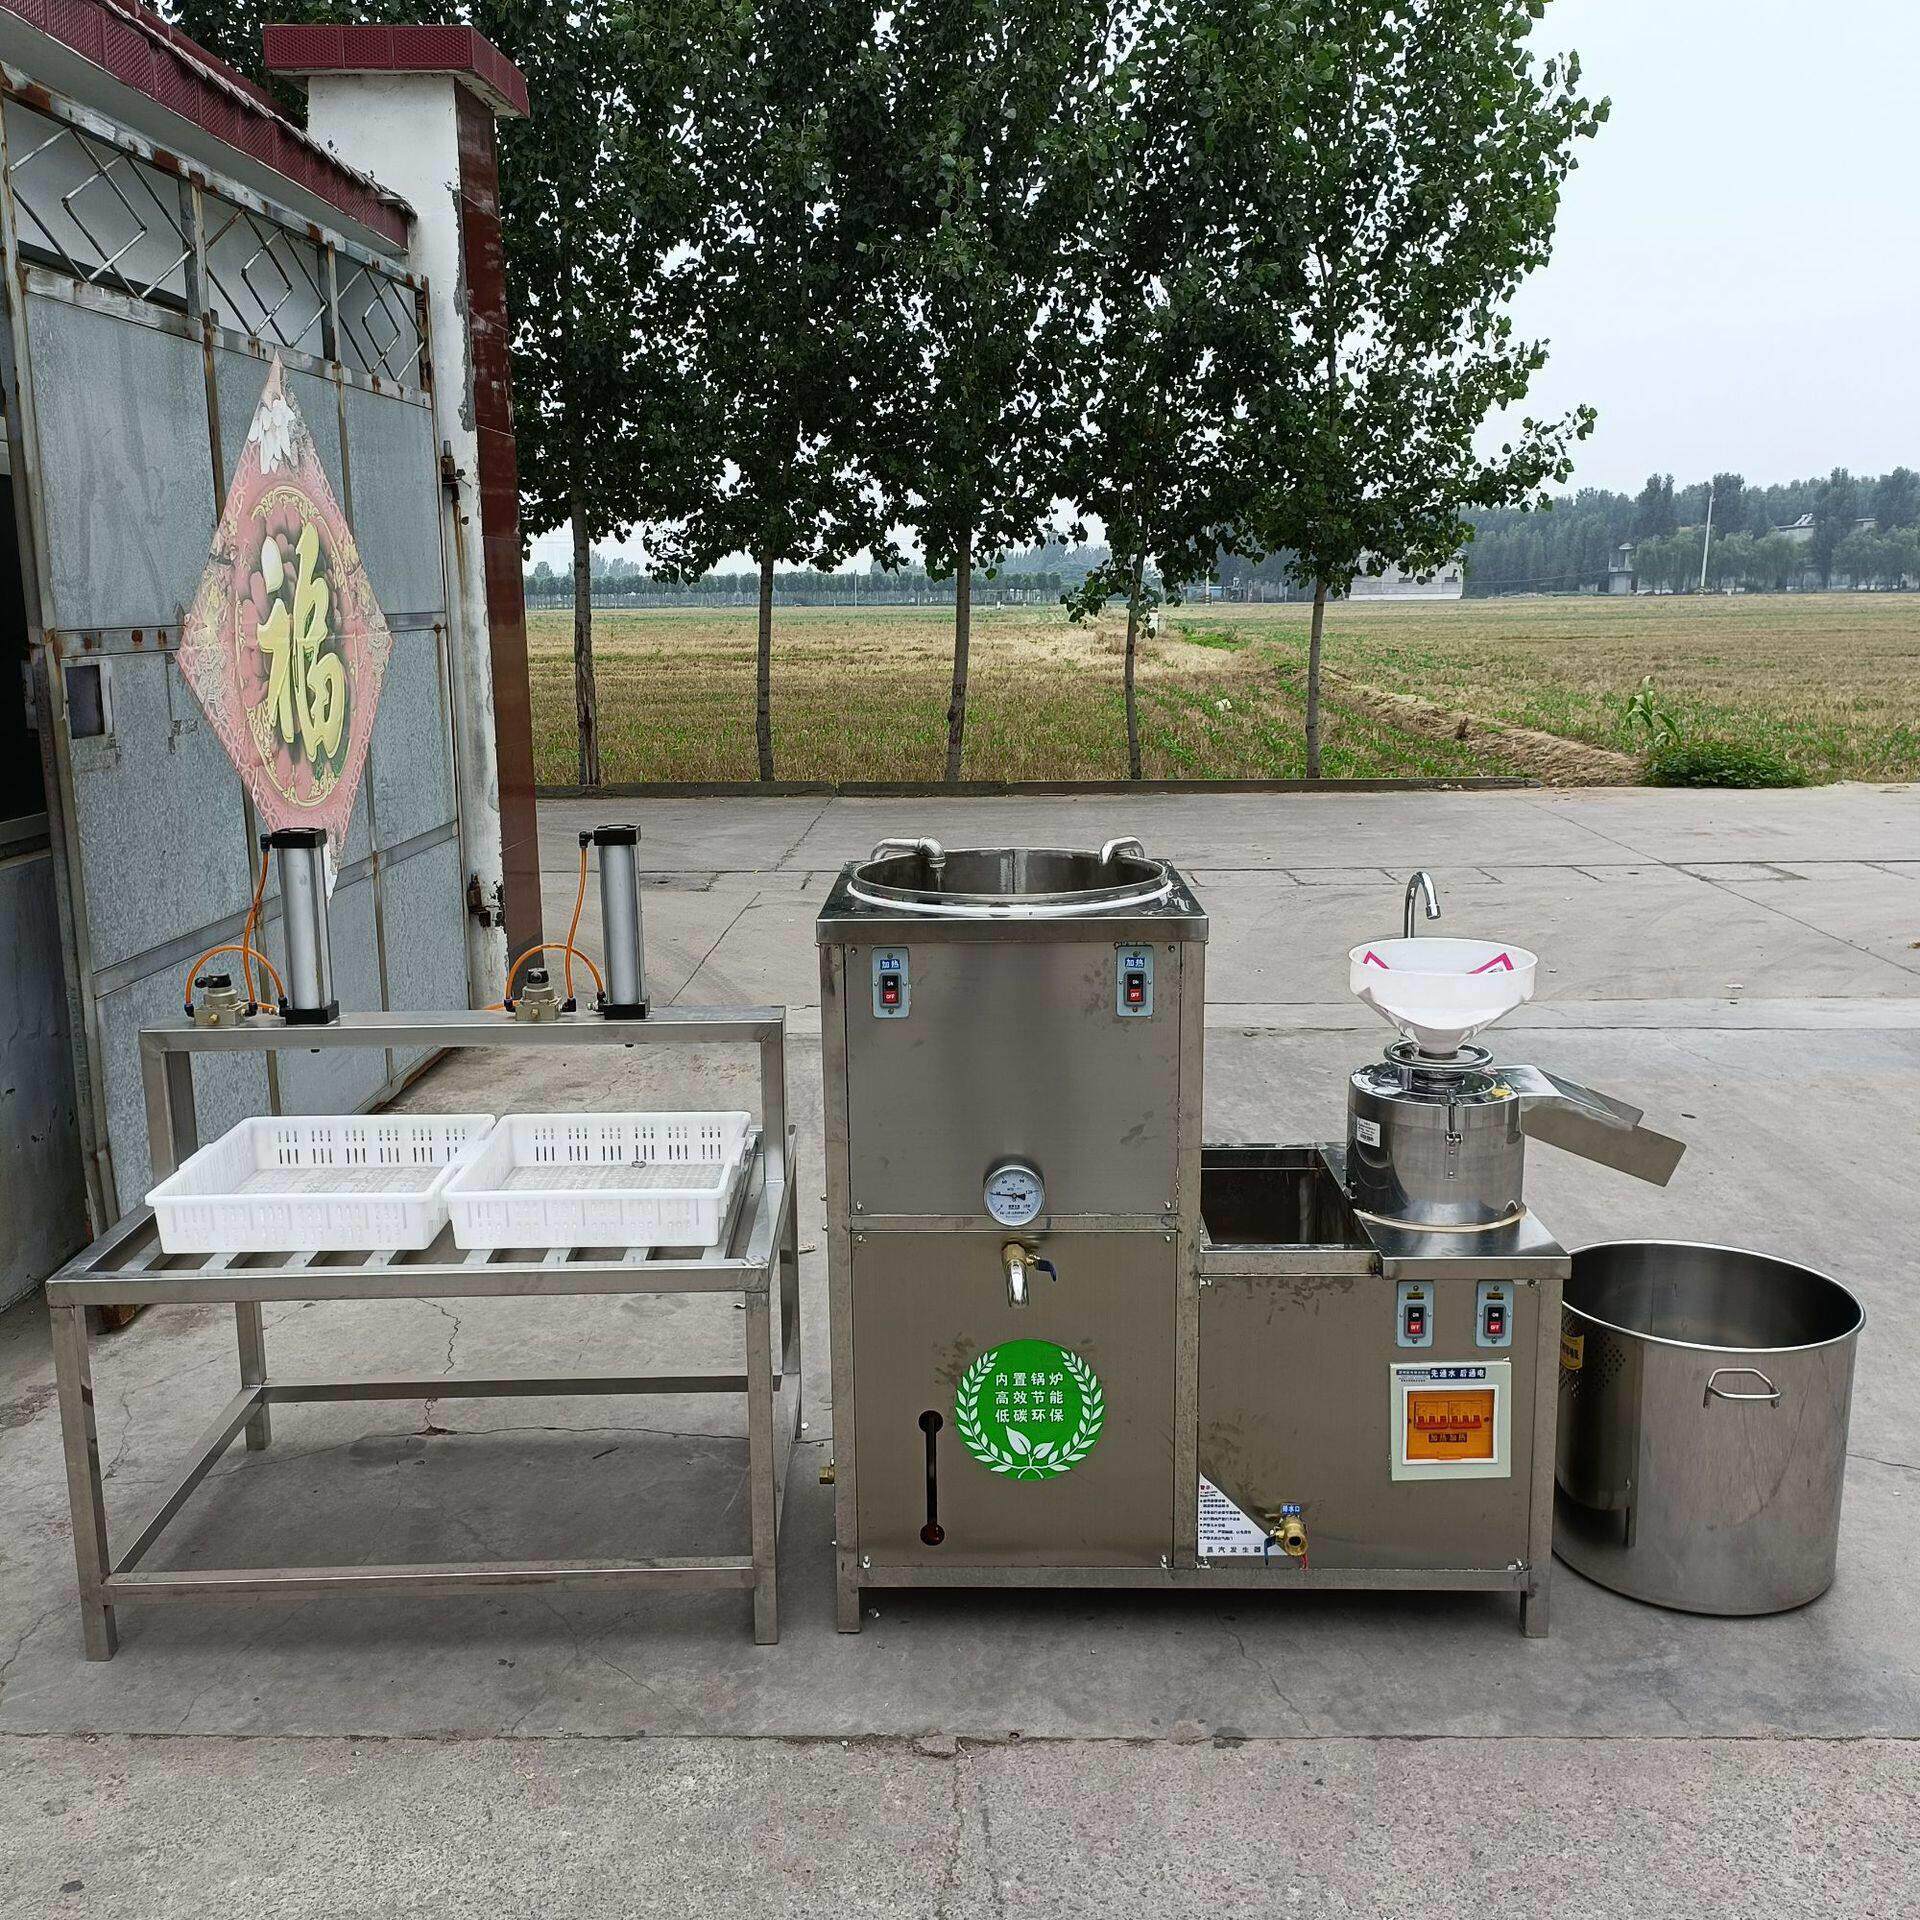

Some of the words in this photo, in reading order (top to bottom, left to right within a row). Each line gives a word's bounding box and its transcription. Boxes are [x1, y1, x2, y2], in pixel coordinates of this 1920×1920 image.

[881, 960, 900, 969] 加热
[1126, 958, 1144, 967] 加热
[995, 1372, 1064, 1387] 内置锅炉
[994, 1390, 1064, 1405] 高效节能
[994, 1408, 1065, 1423] 低碳环保
